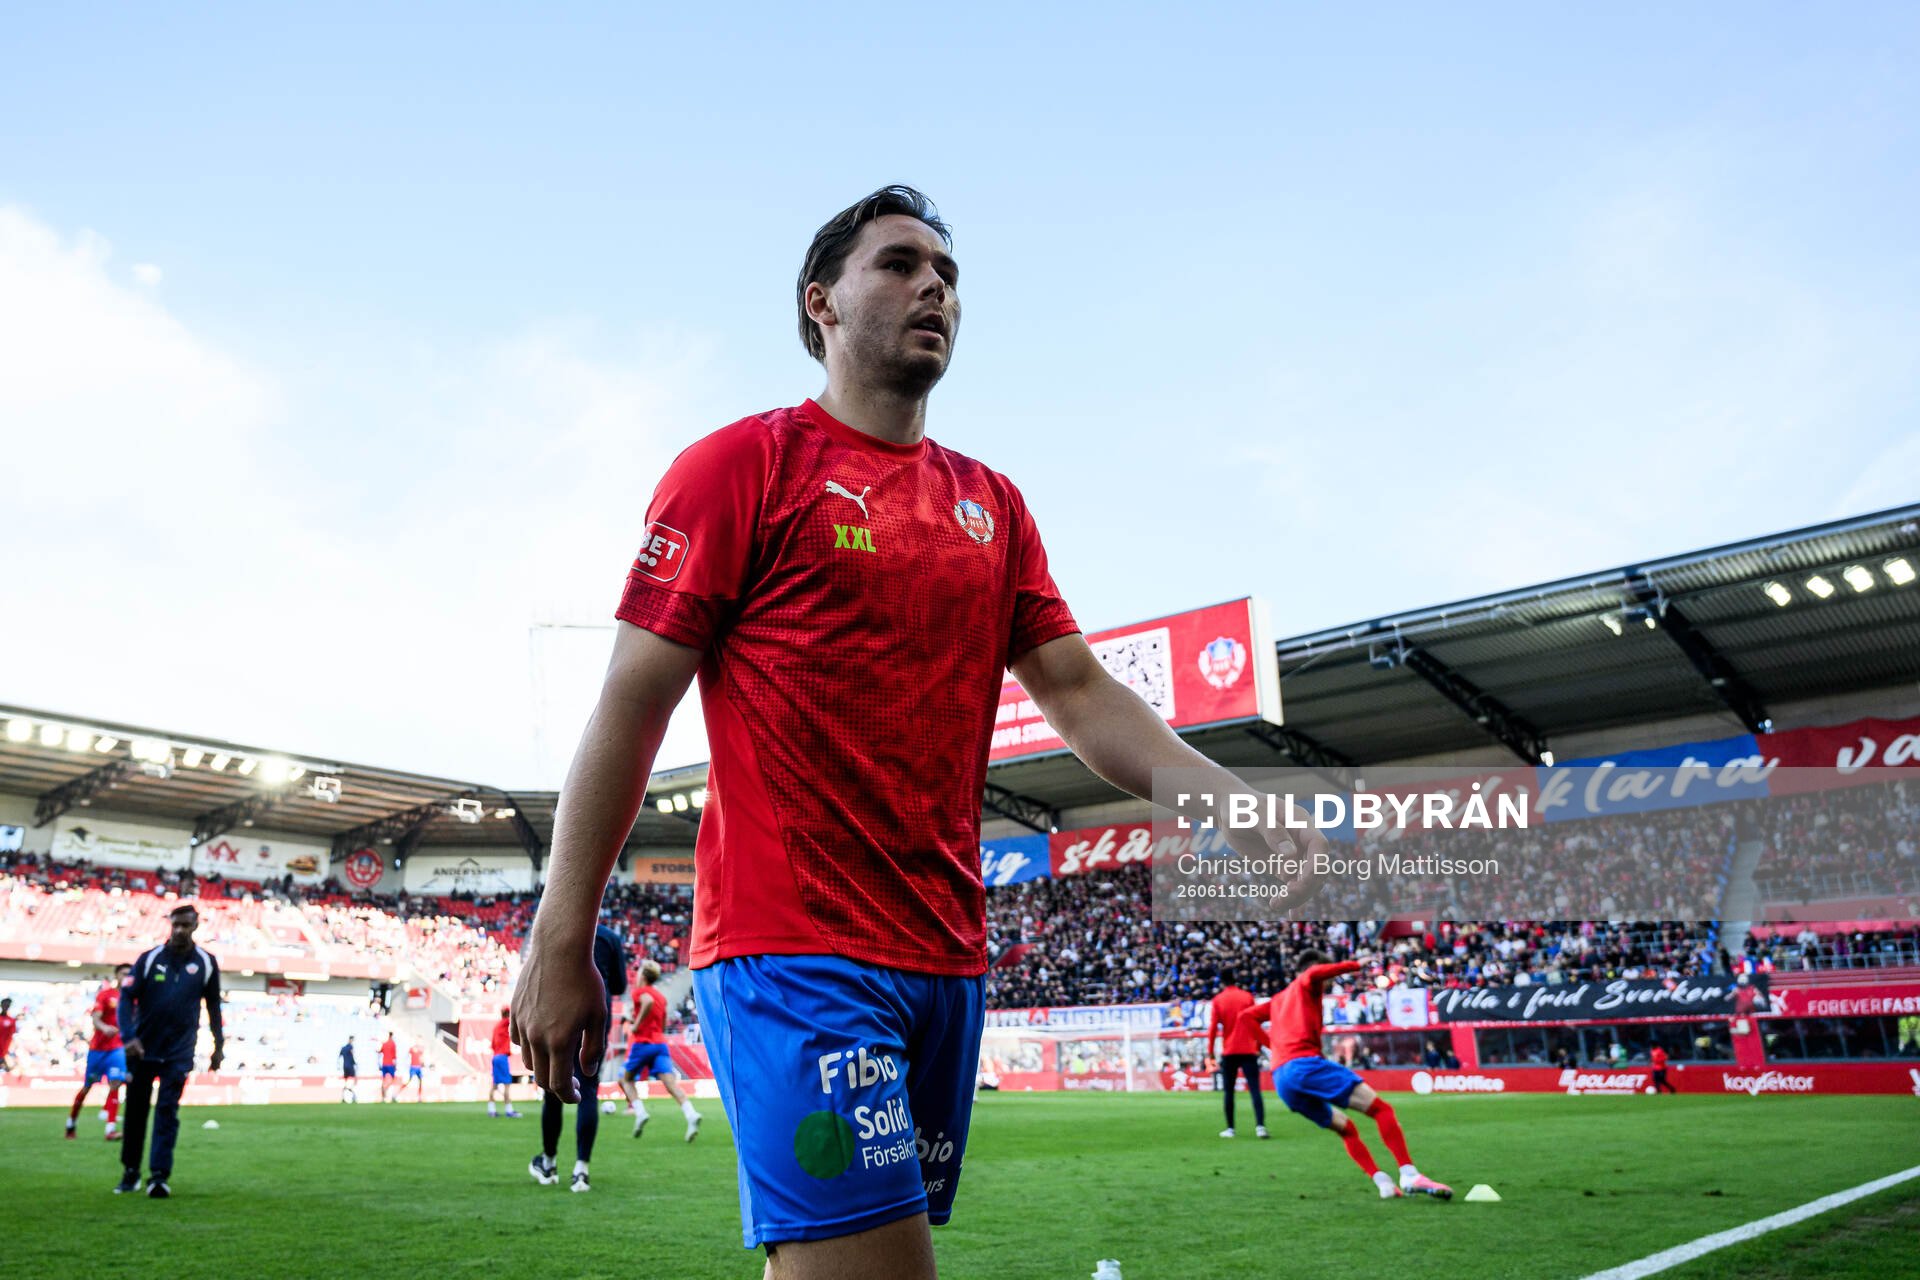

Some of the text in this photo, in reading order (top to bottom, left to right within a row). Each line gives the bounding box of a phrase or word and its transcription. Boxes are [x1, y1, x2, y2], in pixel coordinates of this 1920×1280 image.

[833, 524, 877, 553] XXL
[1534, 754, 1780, 814] klara
[206, 841, 240, 863] MAX
[1432, 986, 1500, 1014] Vila
[1523, 987, 1589, 1019] frid
[1593, 979, 1723, 1011] Sverker
[818, 1047, 898, 1094] Fibio
[854, 1098, 909, 1140] Solid
